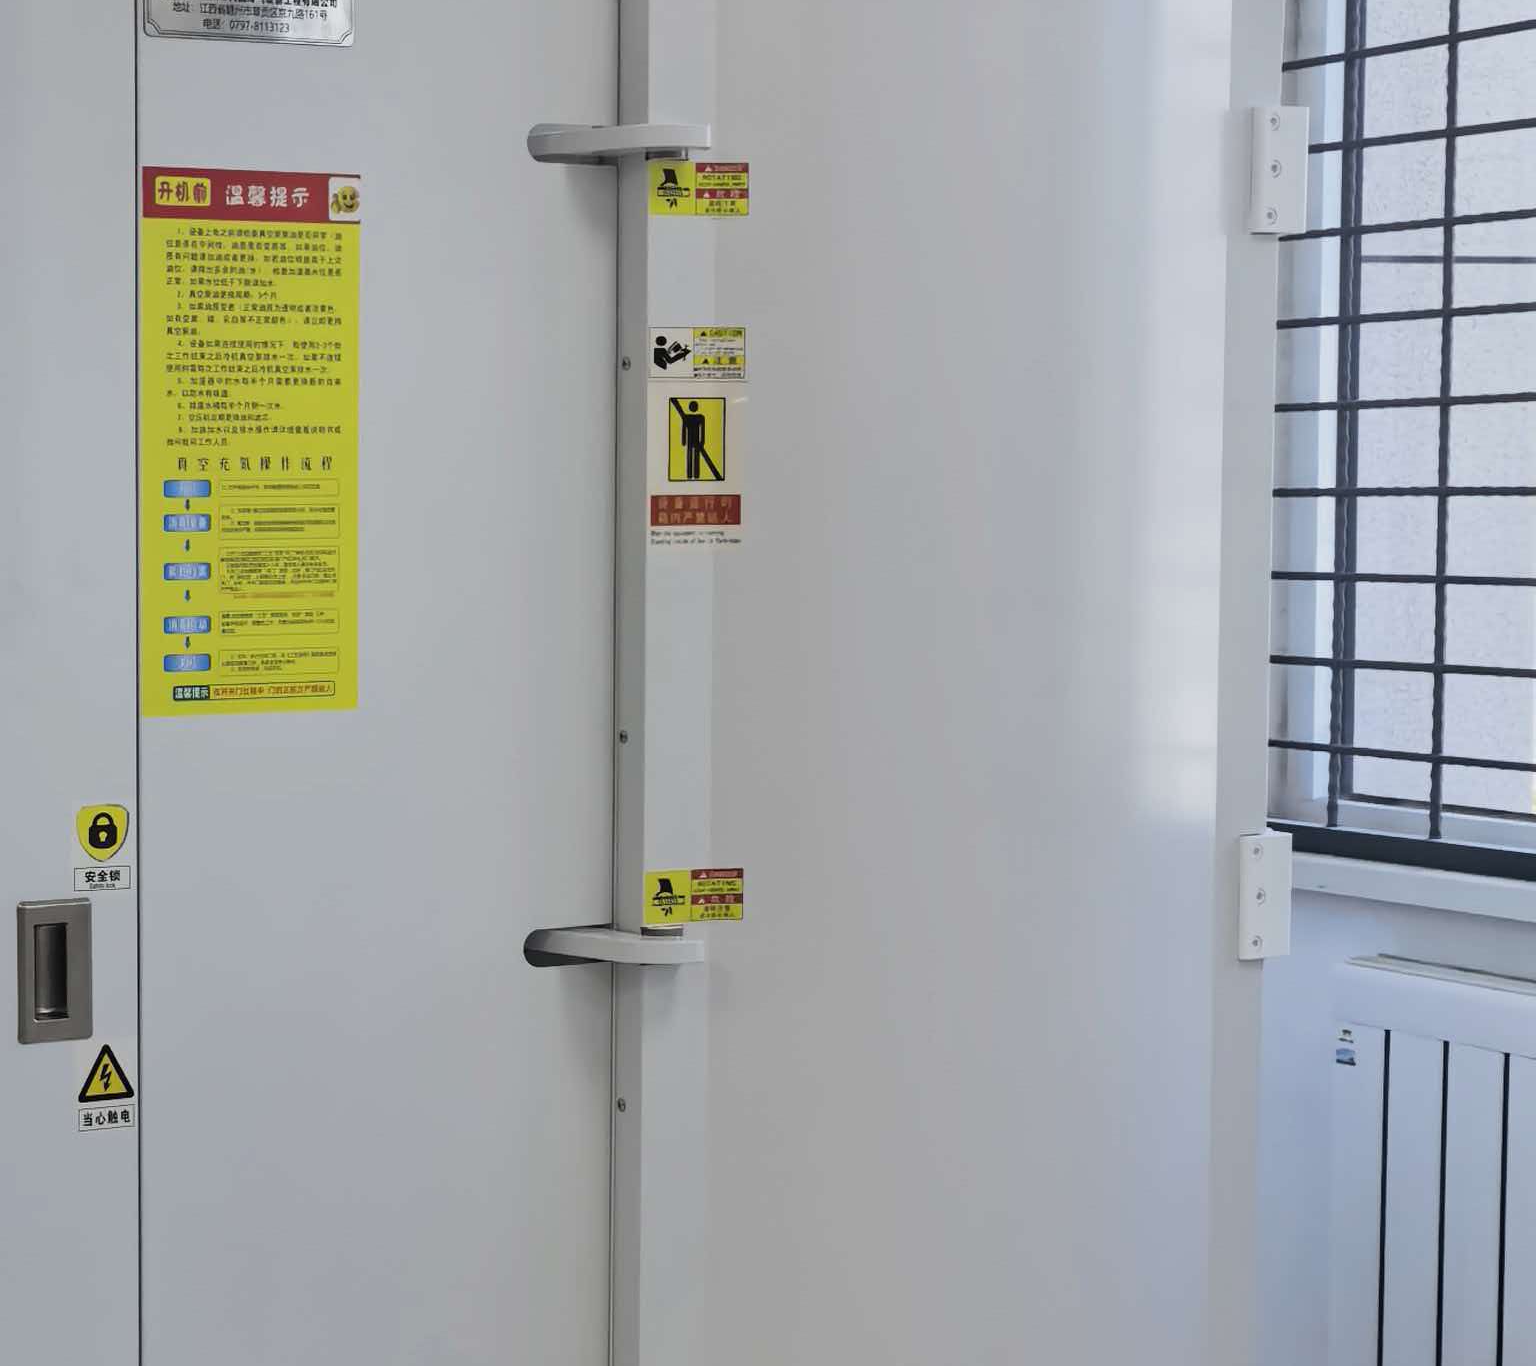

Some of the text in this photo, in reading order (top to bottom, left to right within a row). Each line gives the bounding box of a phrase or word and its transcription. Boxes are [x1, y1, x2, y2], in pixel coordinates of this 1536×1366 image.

[225, 185, 309, 207] 温馨提示
[85, 869, 121, 883] 安全锁
[82, 1109, 131, 1127] 当心触电
